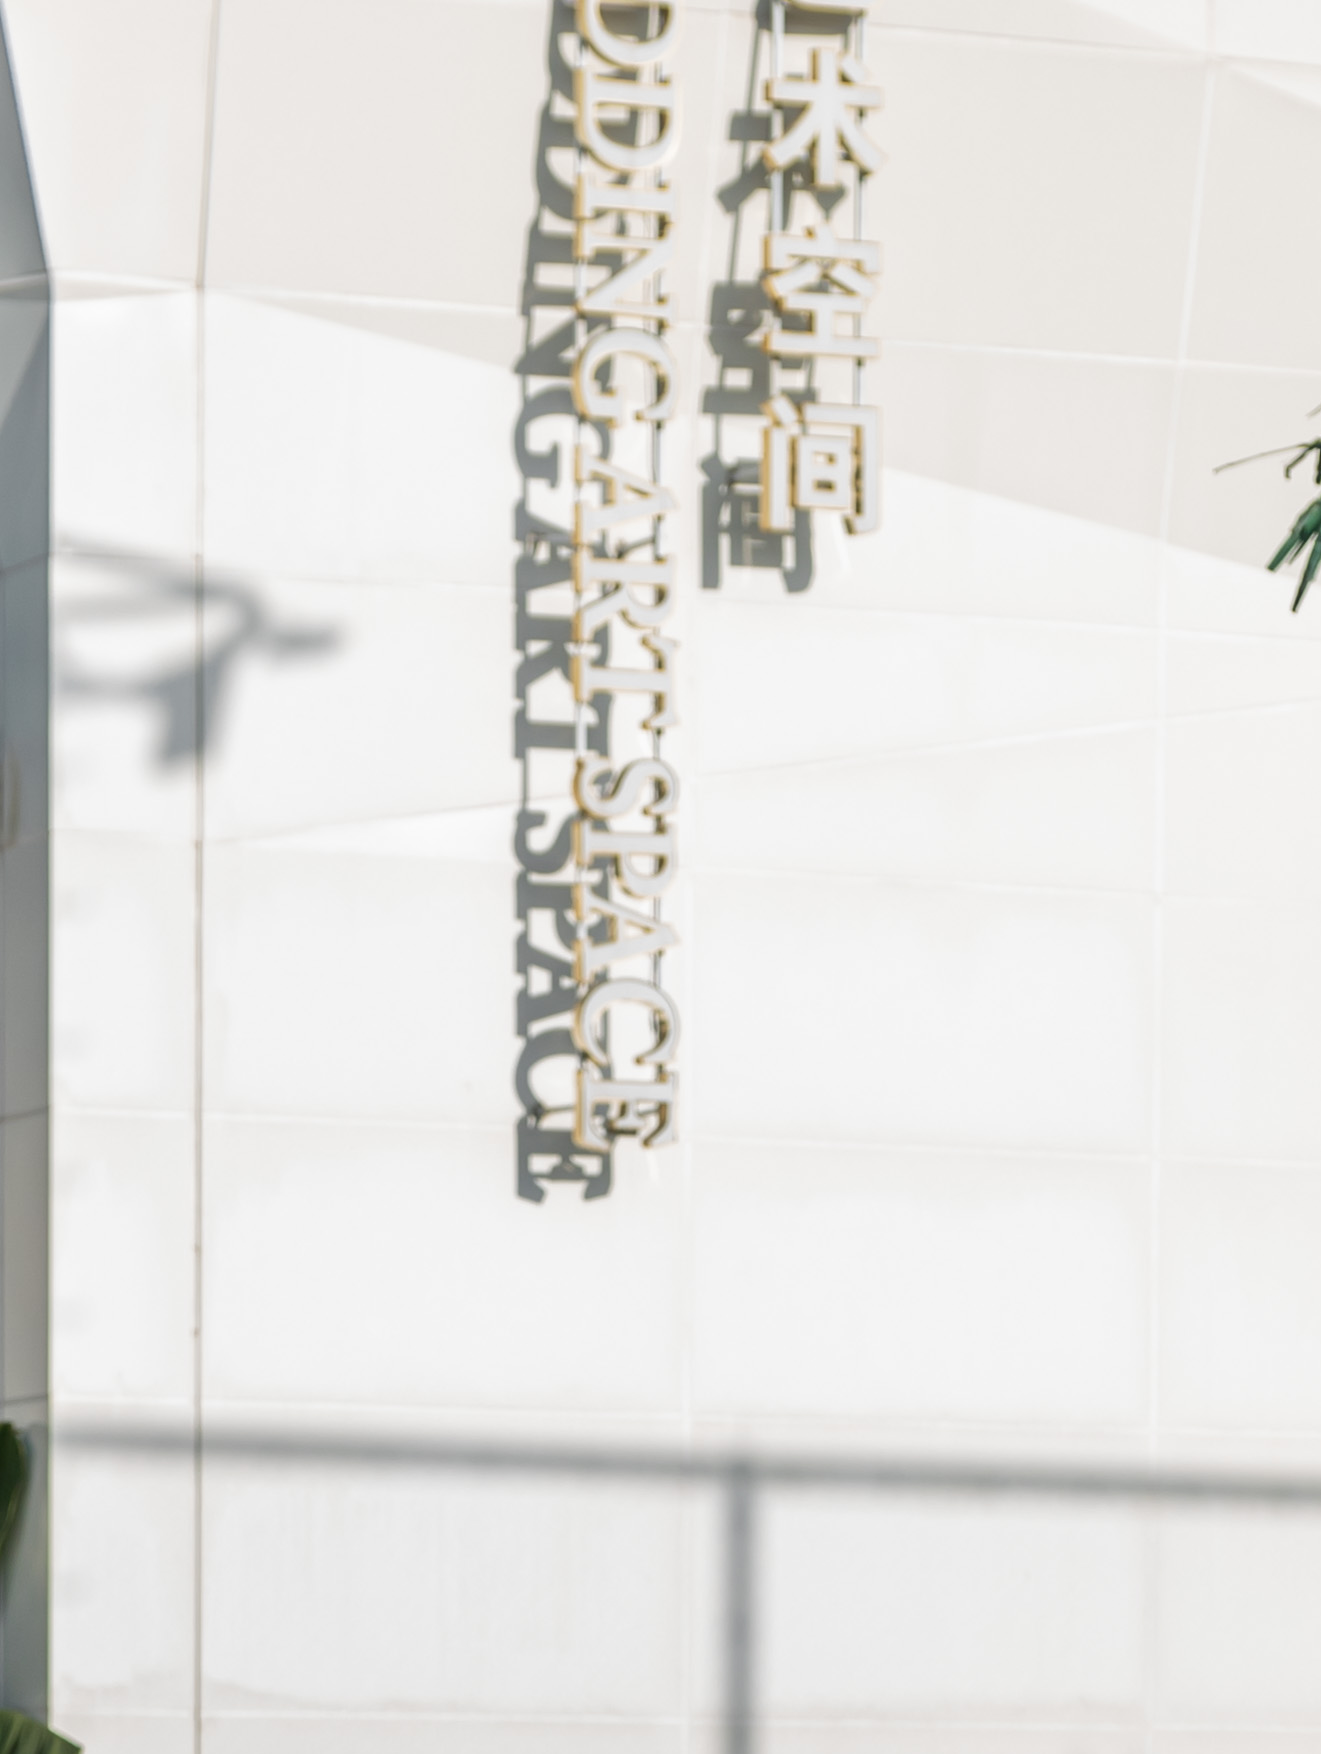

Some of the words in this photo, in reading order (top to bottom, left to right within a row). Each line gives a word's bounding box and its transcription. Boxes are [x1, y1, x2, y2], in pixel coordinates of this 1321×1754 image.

[761, 0, 884, 535] 术空间
[569, 444, 680, 731] ART
[571, 756, 681, 1150] SPACE
